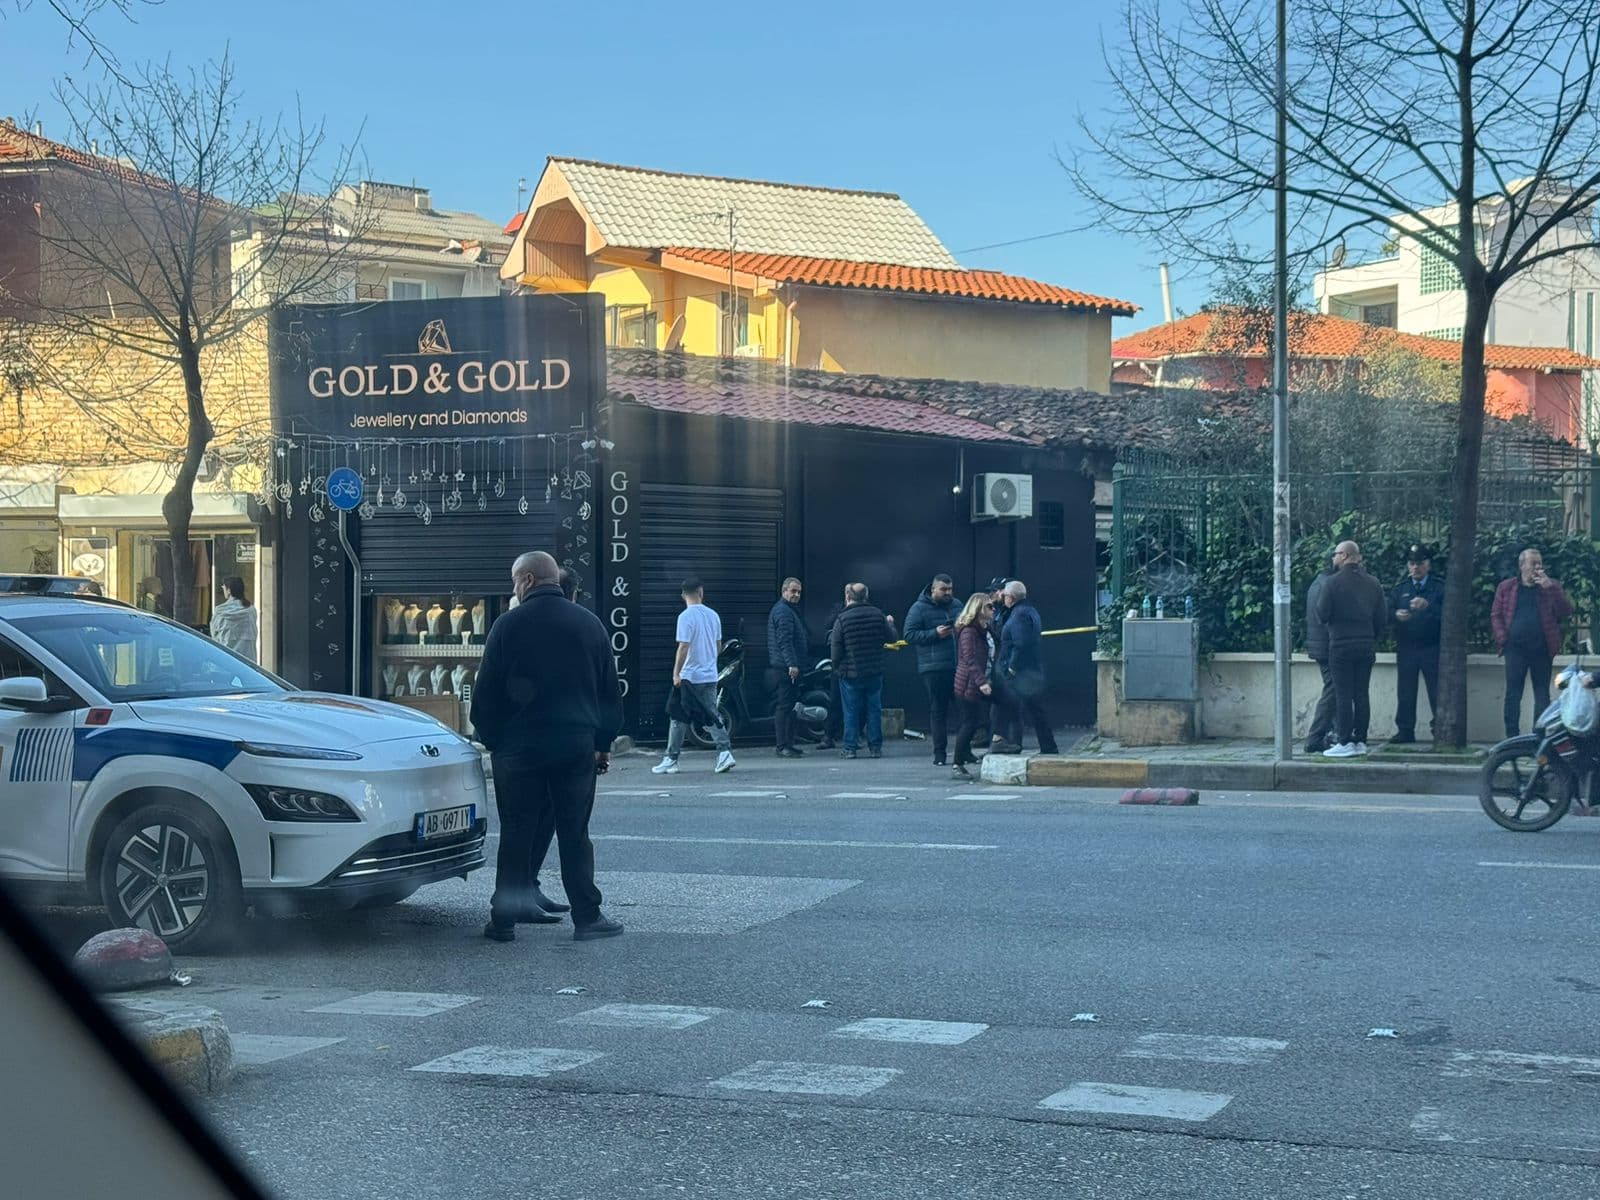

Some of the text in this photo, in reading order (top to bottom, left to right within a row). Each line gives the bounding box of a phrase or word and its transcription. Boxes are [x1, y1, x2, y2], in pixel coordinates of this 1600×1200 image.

[308, 359, 571, 398] GOLD & GOLD
[350, 408, 528, 430] Jewellery and Diamonds
[610, 470, 629, 562] GOLD
[611, 576, 630, 596] &
[426, 815, 438, 834] AB
